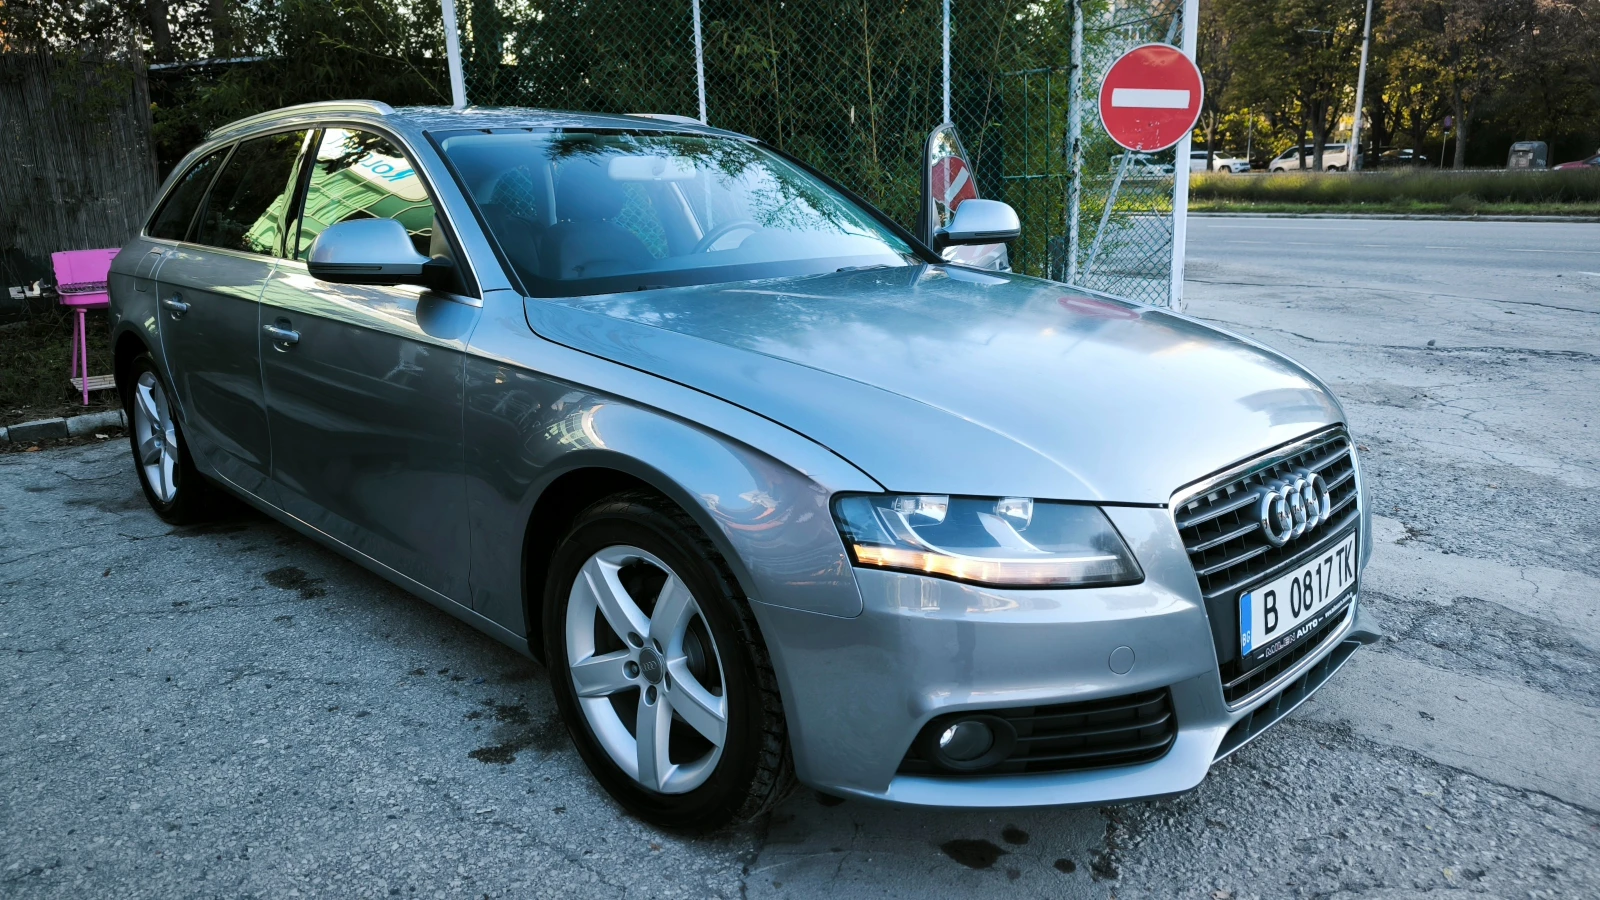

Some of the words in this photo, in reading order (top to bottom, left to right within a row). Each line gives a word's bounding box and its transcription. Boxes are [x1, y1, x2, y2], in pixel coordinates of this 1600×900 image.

[1264, 589, 1279, 635] B
[1290, 554, 1333, 618] 0817
[1336, 540, 1353, 588] TK
[1242, 630, 1251, 647] BG
[1296, 618, 1318, 639] AUTO
